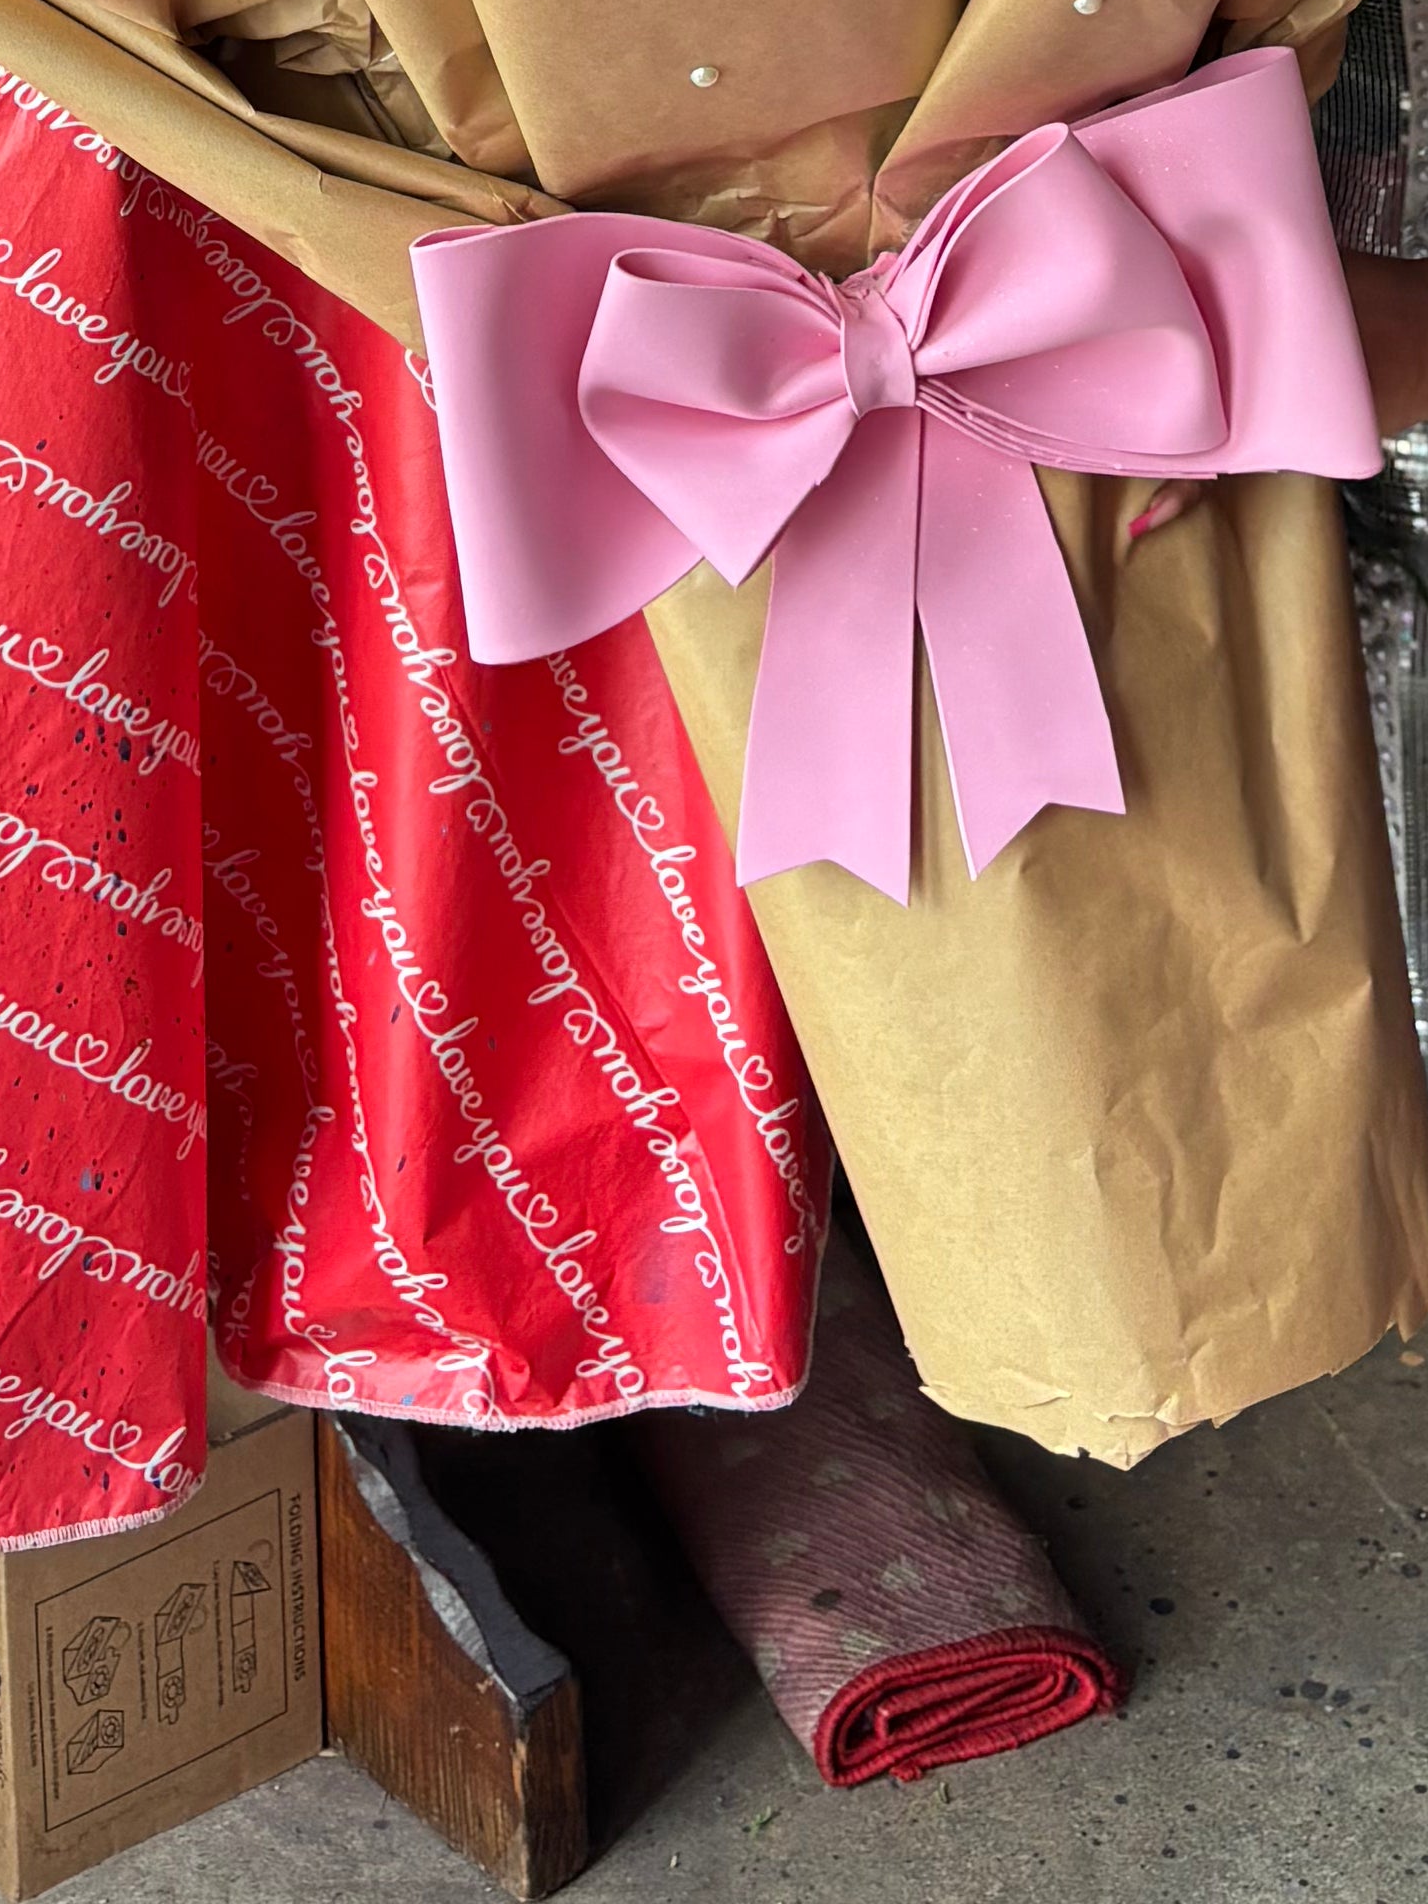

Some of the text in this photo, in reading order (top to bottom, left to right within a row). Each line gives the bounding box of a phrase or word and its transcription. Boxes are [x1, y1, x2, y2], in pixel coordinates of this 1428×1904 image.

[14, 248, 111, 342] love
[294, 322, 362, 420] you
[31, 460, 130, 534] you
[345, 432, 379, 534] love
[120, 520, 198, 607] love
[272, 510, 330, 606] love
[66, 648, 153, 736] love
[384, 594, 481, 794] love you
[350, 770, 384, 884] love
[82, 857, 172, 924] you
[490, 828, 578, 1004] love you
[559, 710, 640, 802] you
[650, 845, 706, 959] love
[682, 958, 748, 1060] you
[361, 884, 422, 987] you
[111, 1038, 184, 1121] love
[431, 1017, 483, 1120] love
[594, 1037, 679, 1130] you
[299, 1105, 337, 1208] love
[454, 1120, 529, 1212] you
[650, 1127, 709, 1234] love
[272, 1222, 308, 1328] you
[372, 1226, 448, 1310] you
[545, 1229, 609, 1334] love
[4, 1382, 103, 1452] you
[289, 1493, 307, 1682] FOLDING INSTRUCTIONS
